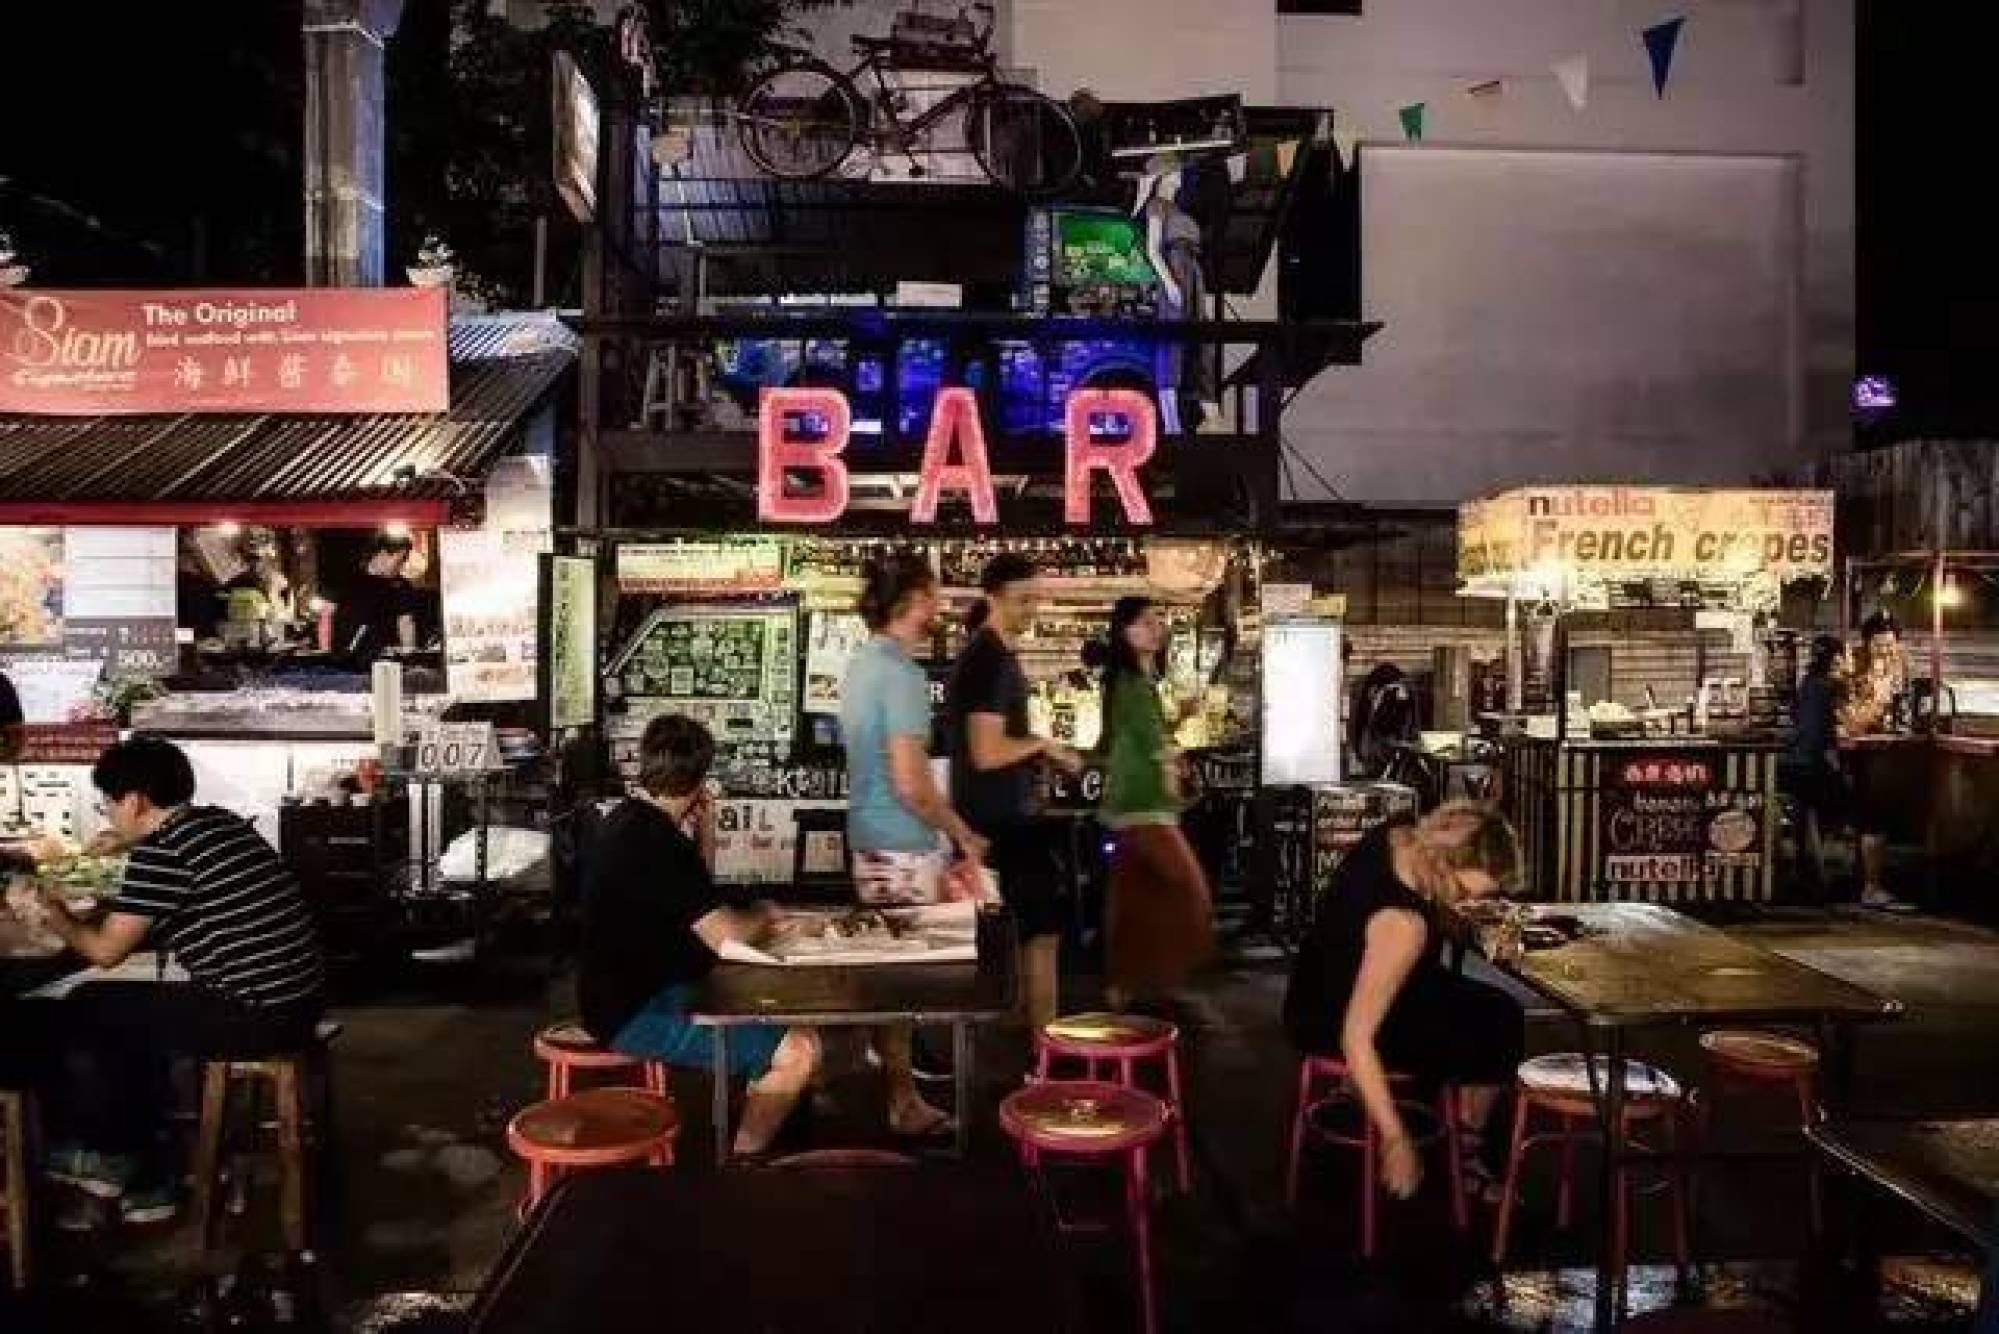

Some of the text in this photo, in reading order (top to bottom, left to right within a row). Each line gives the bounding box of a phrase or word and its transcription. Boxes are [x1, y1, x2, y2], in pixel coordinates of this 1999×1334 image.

[3, 296, 141, 369] Siam
[143, 299, 296, 328] The Original
[758, 387, 1157, 525] BAR
[1529, 494, 1656, 517] nutella
[1532, 519, 1675, 561] French
